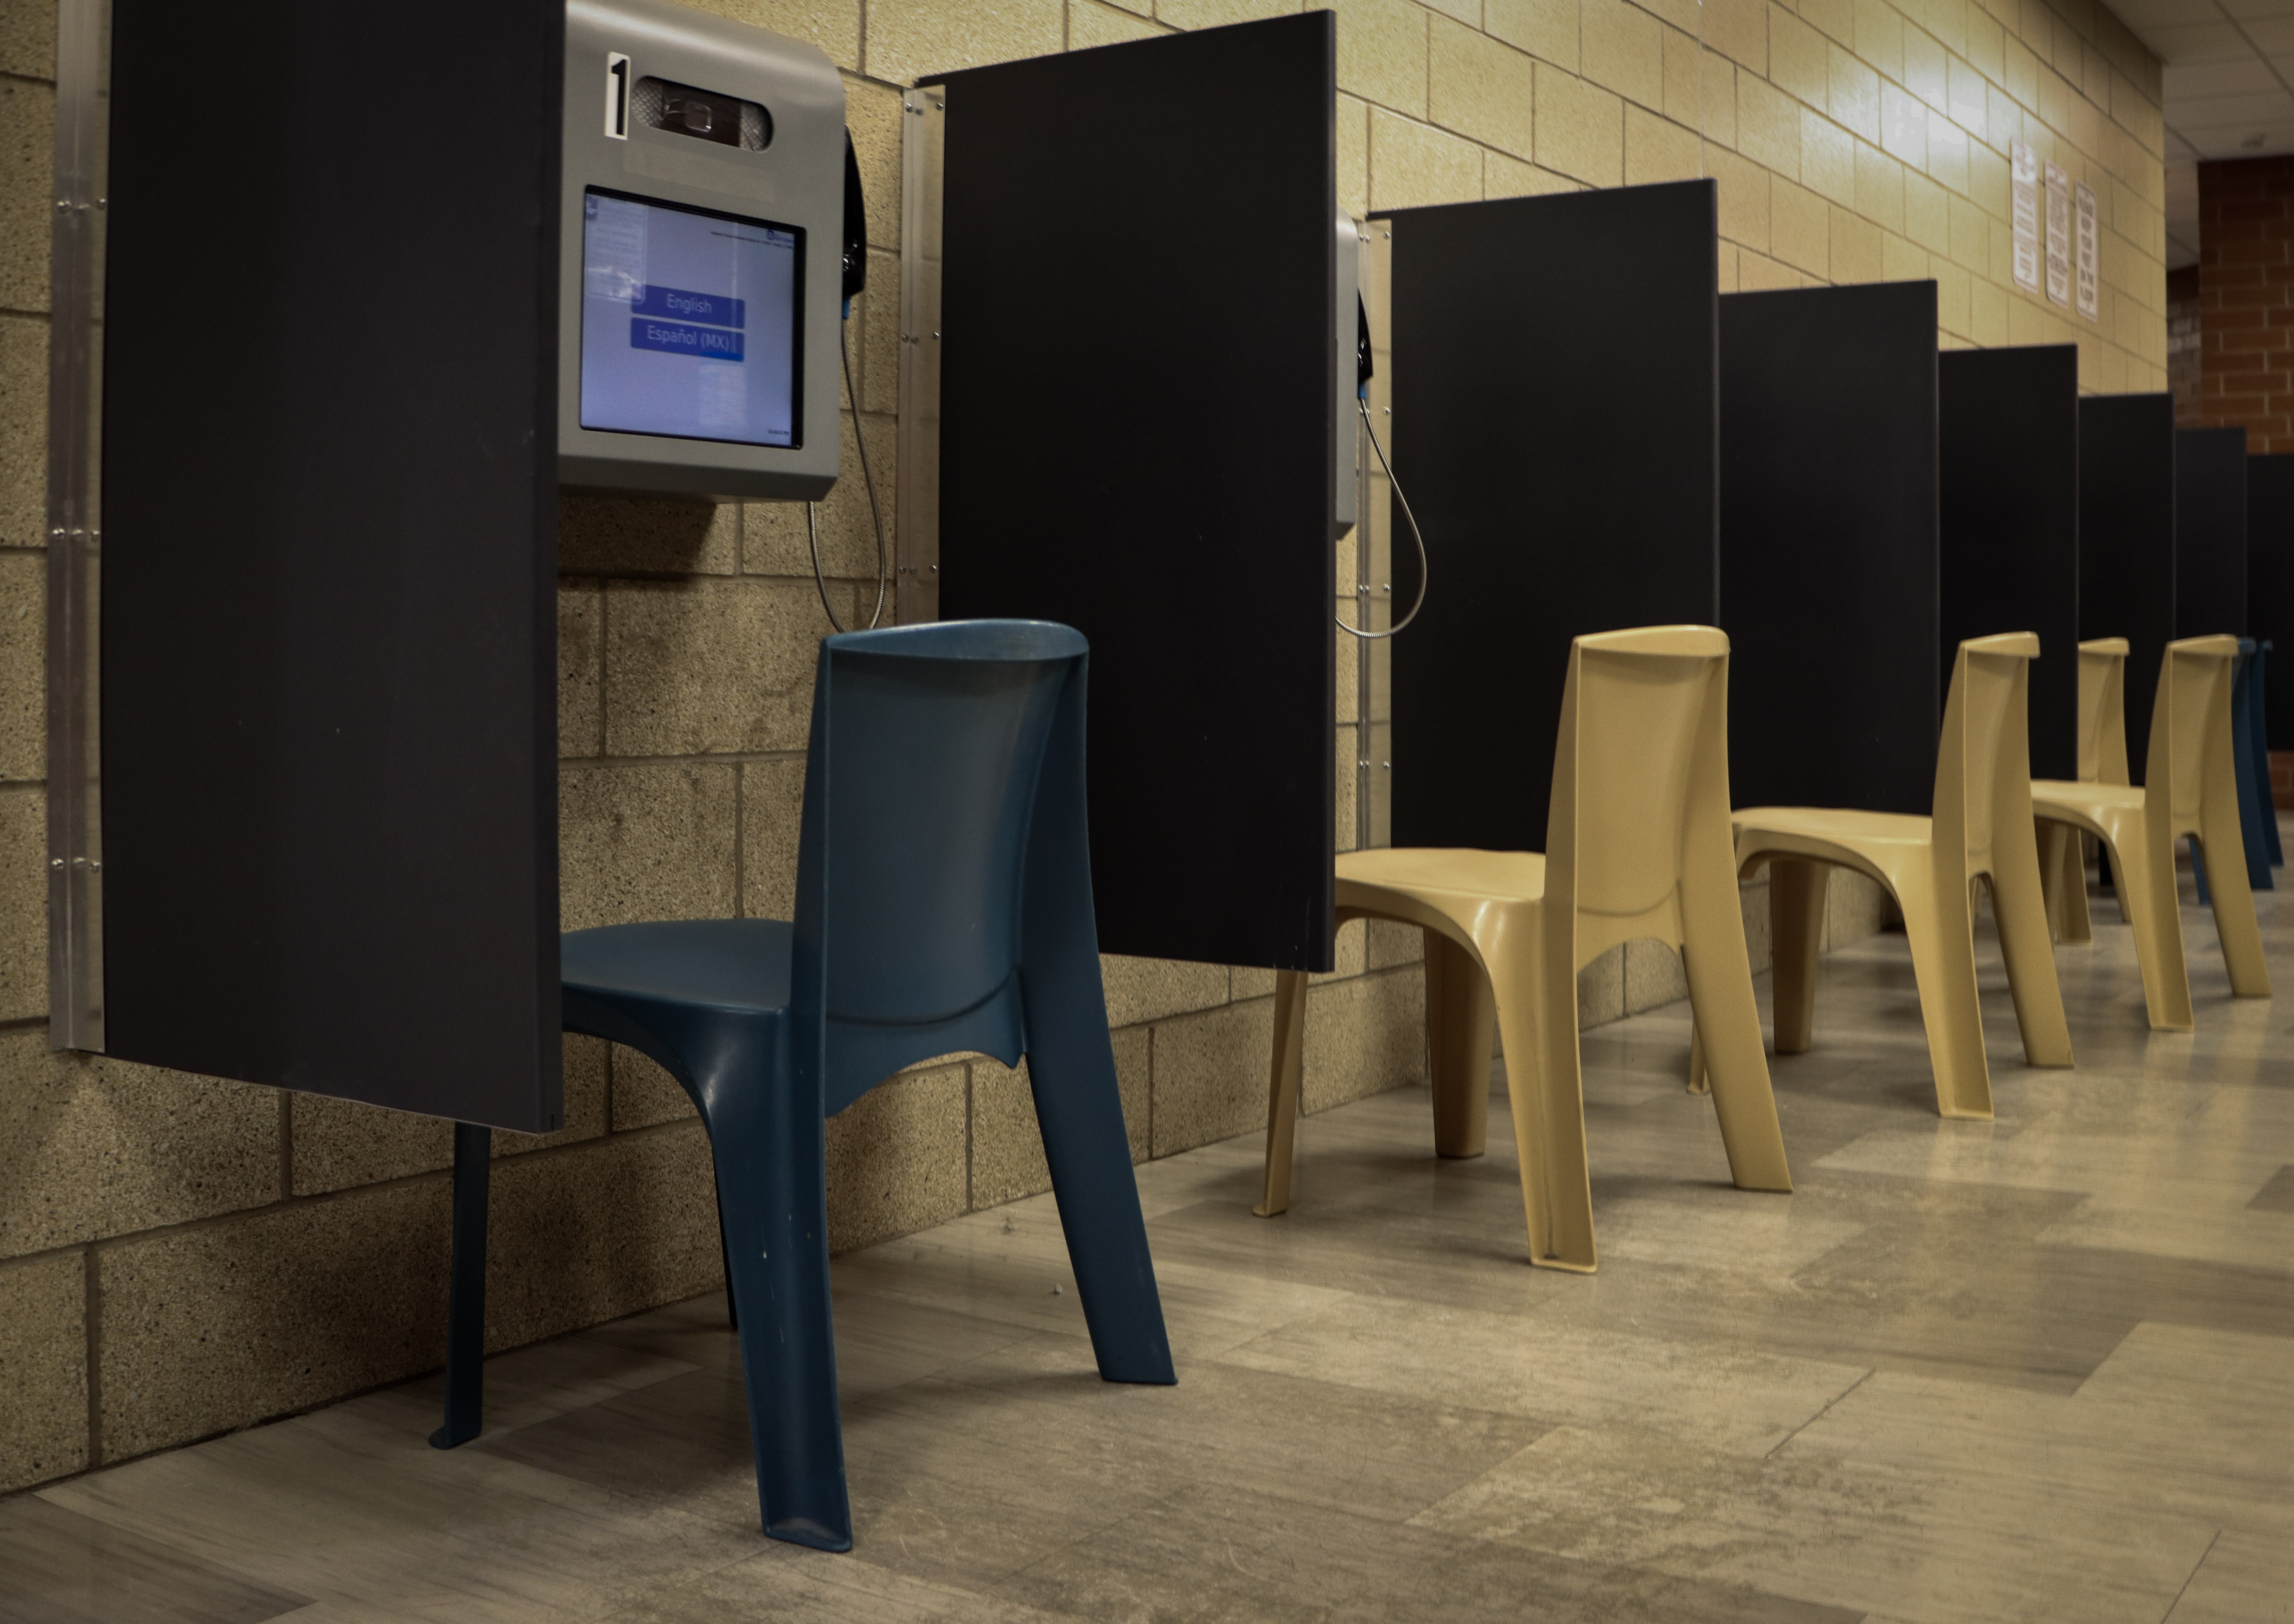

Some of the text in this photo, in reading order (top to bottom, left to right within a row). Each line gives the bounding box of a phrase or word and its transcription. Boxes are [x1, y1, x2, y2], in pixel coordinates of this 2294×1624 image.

[612, 58, 627, 136] 1
[667, 293, 712, 314] English
[647, 325, 729, 352] Español (MX)
